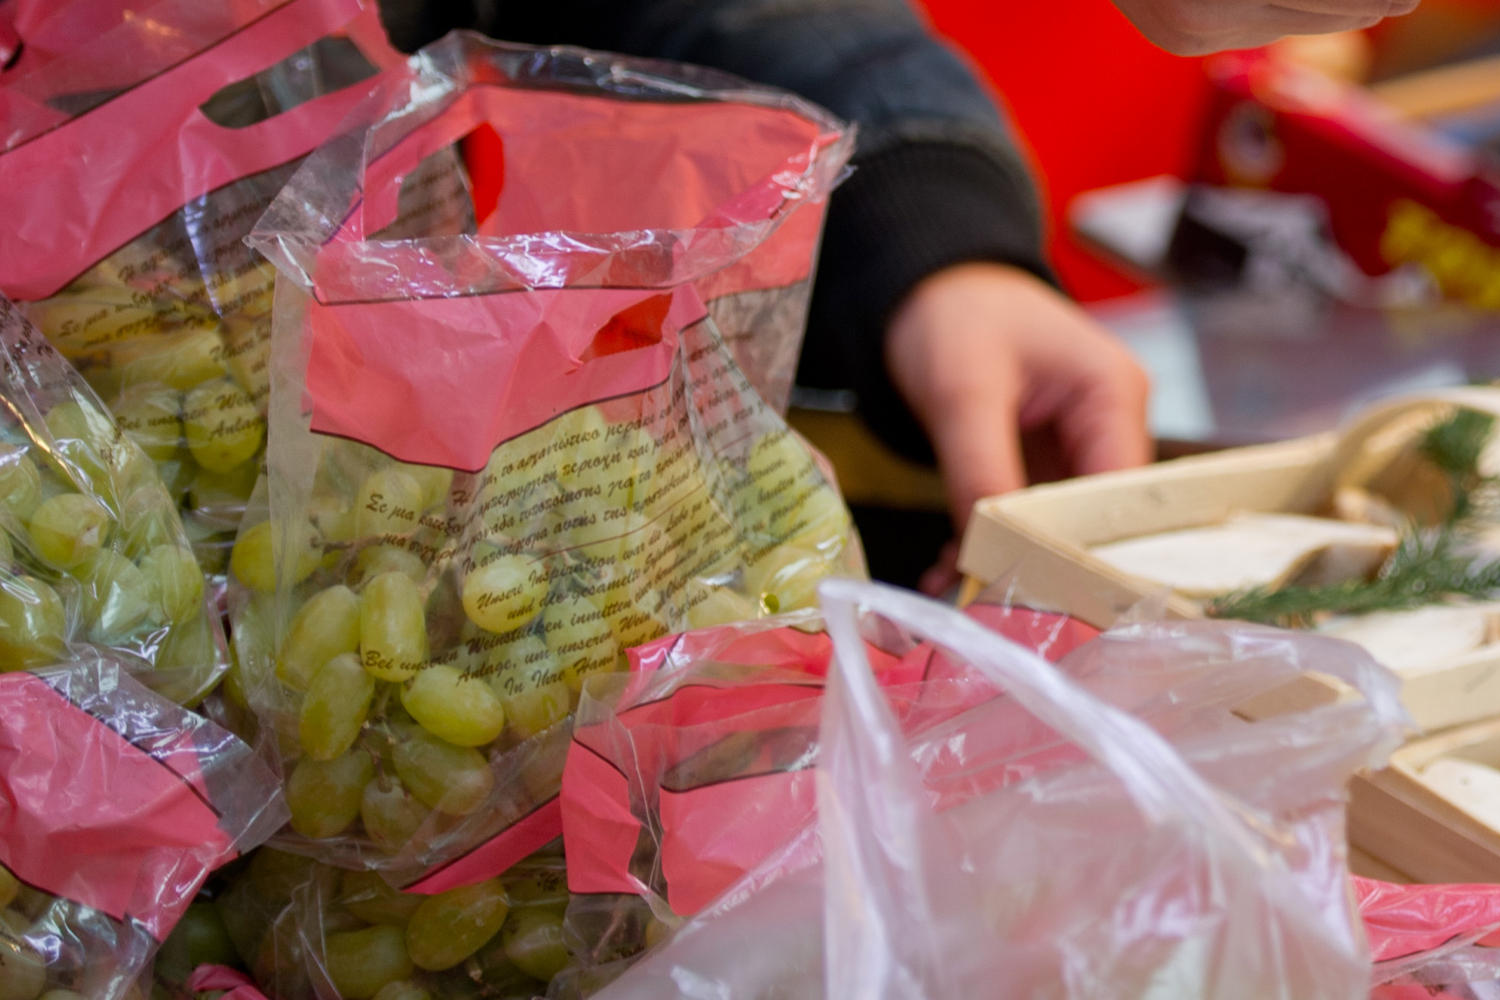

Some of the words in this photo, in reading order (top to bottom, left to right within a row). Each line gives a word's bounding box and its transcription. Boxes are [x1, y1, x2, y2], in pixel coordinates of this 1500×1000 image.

[476, 584, 523, 611] Unsere
[529, 555, 616, 589] Inspiration
[506, 598, 536, 620] und
[363, 649, 395, 671] Bei
[455, 657, 518, 689] Anlage,
[524, 649, 550, 665] um
[503, 676, 525, 697] In
[531, 668, 567, 689] Ihre
